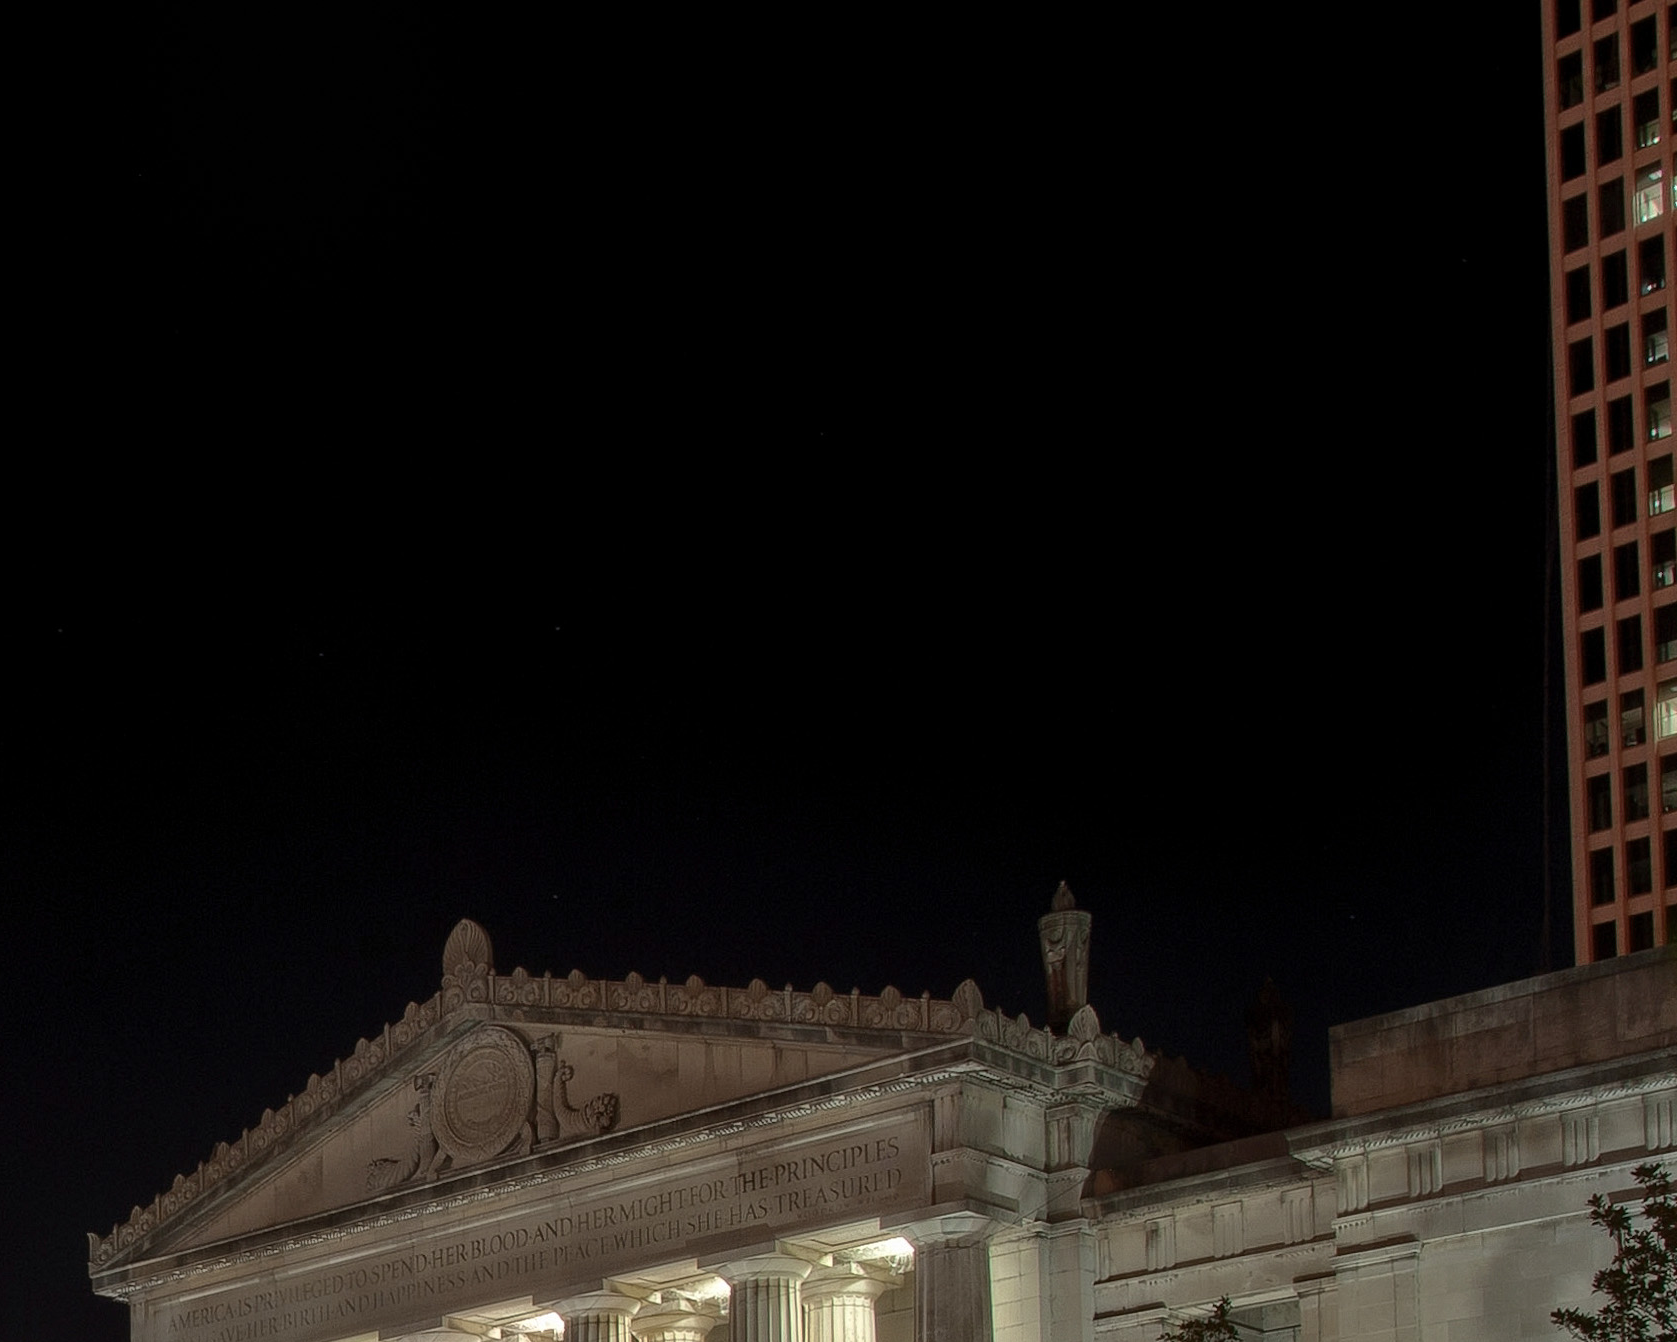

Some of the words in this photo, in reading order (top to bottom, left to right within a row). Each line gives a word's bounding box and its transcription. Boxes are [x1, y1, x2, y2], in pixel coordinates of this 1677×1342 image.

[168, 1303, 234, 1334] AMERICA
[238, 1297, 252, 1318] IS
[254, 1275, 344, 1312] PRIVILEGED
[347, 1268, 367, 1290] TO
[372, 1254, 428, 1283] SPEND
[432, 1243, 467, 1269] HER
[471, 1228, 529, 1259] BLOOD
[533, 1216, 573, 1244] AND
[578, 1206, 616, 1233] HER
[619, 1189, 686, 1223] MIGHT
[689, 1179, 726, 1206] FOR
[730, 1168, 769, 1195] THE
[775, 1136, 900, 1186] PRINCIPLES
[247, 1317, 279, 1340] HER
[283, 1304, 330, 1331] BIRTH
[333, 1294, 370, 1317] AND
[374, 1270, 465, 1309] HAPPINESS
[473, 1260, 509, 1285] AND
[512, 1247, 548, 1275] THE
[554, 1236, 610, 1266] PEACE
[614, 1219, 680, 1250] WHICH
[685, 1209, 722, 1236] SHE
[730, 1199, 768, 1226] HAS
[775, 1168, 902, 1214] TREASURED
